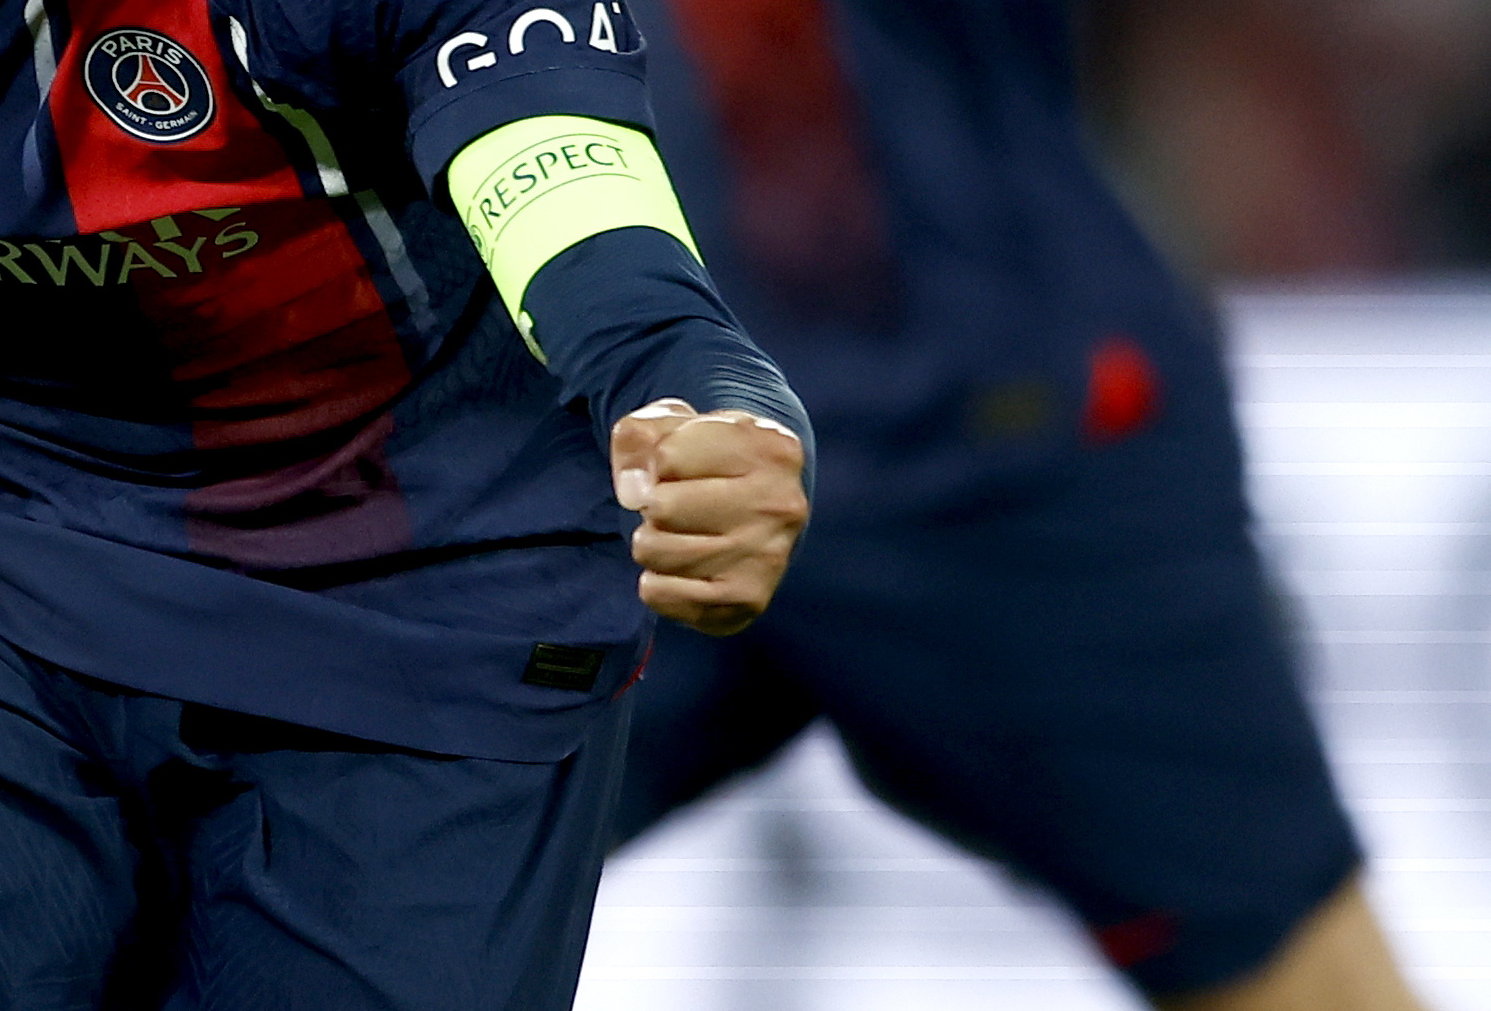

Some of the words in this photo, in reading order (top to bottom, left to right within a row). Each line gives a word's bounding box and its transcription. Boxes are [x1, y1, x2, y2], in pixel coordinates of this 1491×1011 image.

[101, 35, 184, 65] PARIS
[437, 2, 621, 88] GOA
[480, 143, 628, 229] RESPECT
